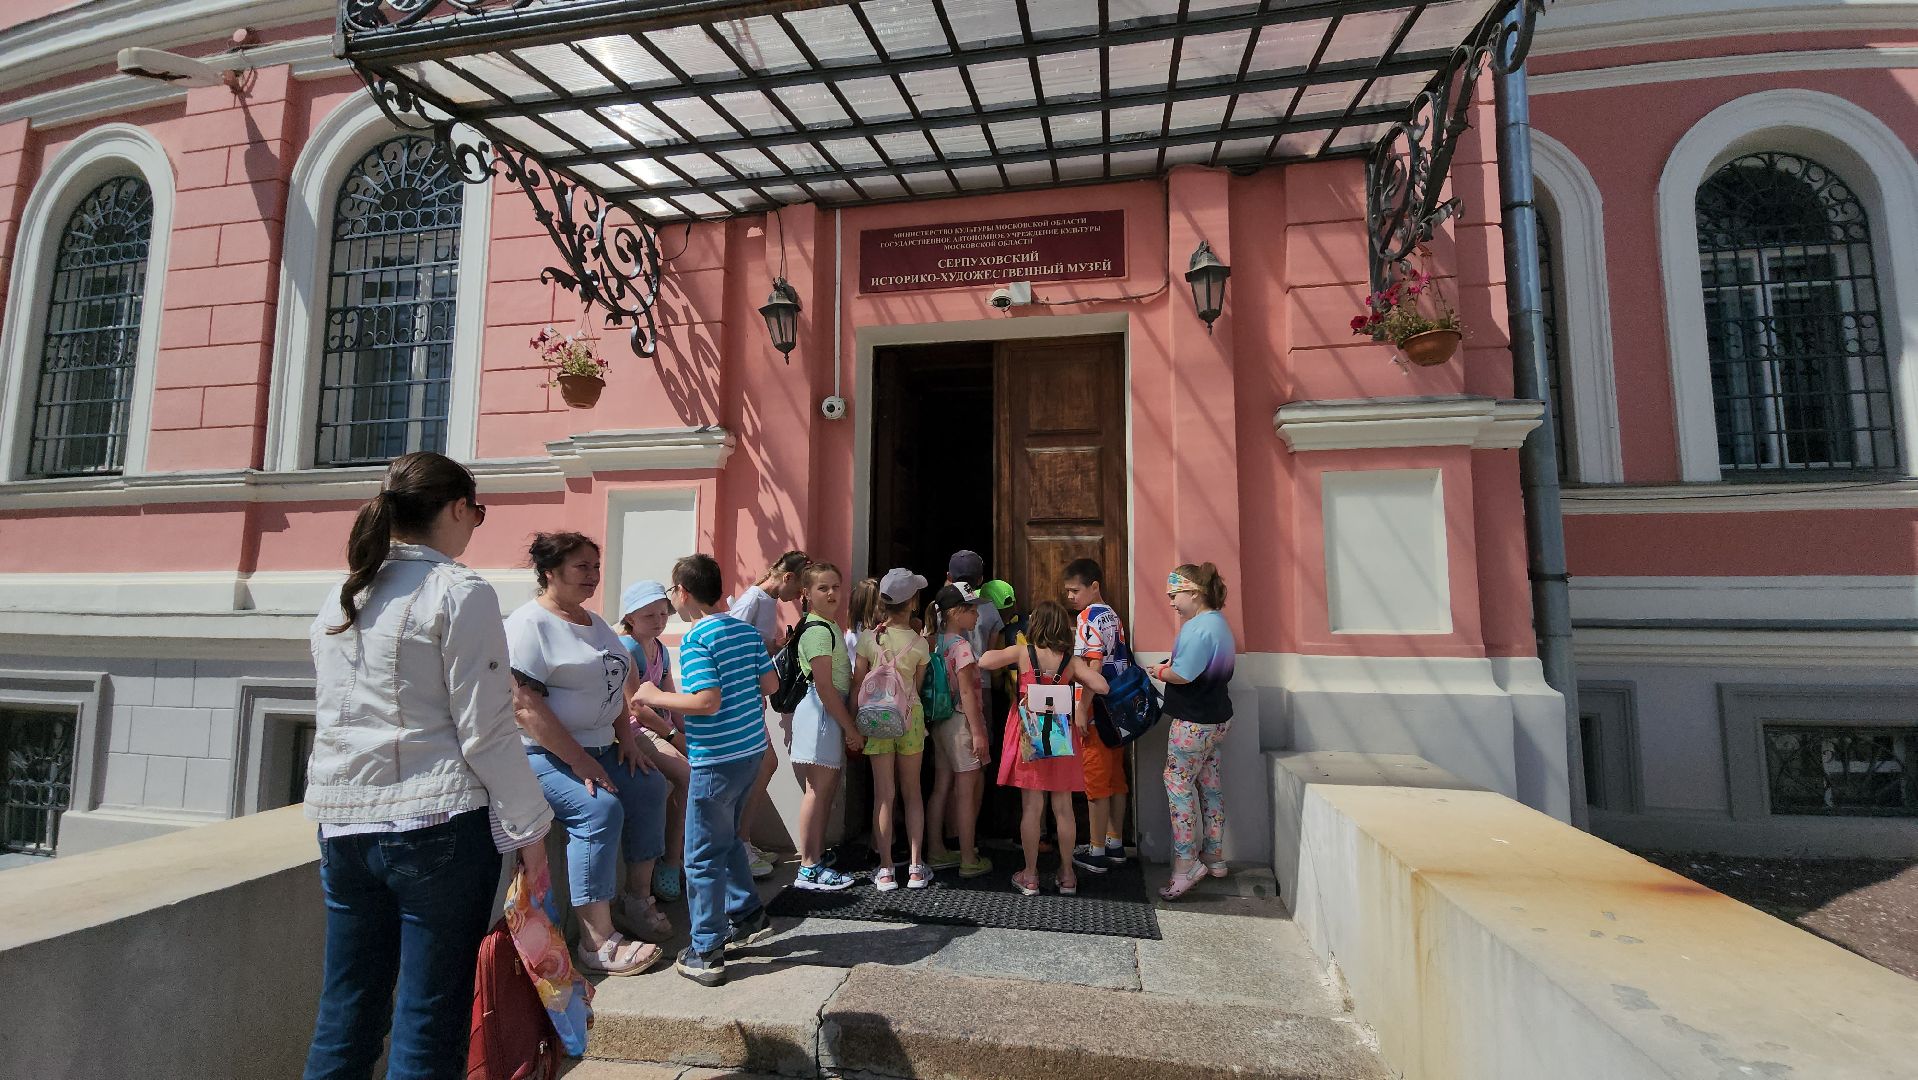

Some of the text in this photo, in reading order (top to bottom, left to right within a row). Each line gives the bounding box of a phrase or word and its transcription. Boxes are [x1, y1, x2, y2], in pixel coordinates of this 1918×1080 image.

[880, 226, 1101, 248] ГОСУДАРСТВЕННОЕ АВТОНОМНОЕ УЧРЕЖДЕНИЕ КУЛЬТУРЫ
[893, 217, 1087, 238] МИНИСТЕРСТВО КУЛЬТУРЫ МОСКОВСКОЙ ОБЛАСТИ
[944, 238, 1033, 250] МОСКОВСКОЙ ОБЛАСТИ
[937, 250, 1039, 269] СЕРПУХОВСКИЙ
[871, 259, 1112, 286] ИСТОРИКО-ХУДОЖЕСТВЕННЫЙ МУЗЕЙ
